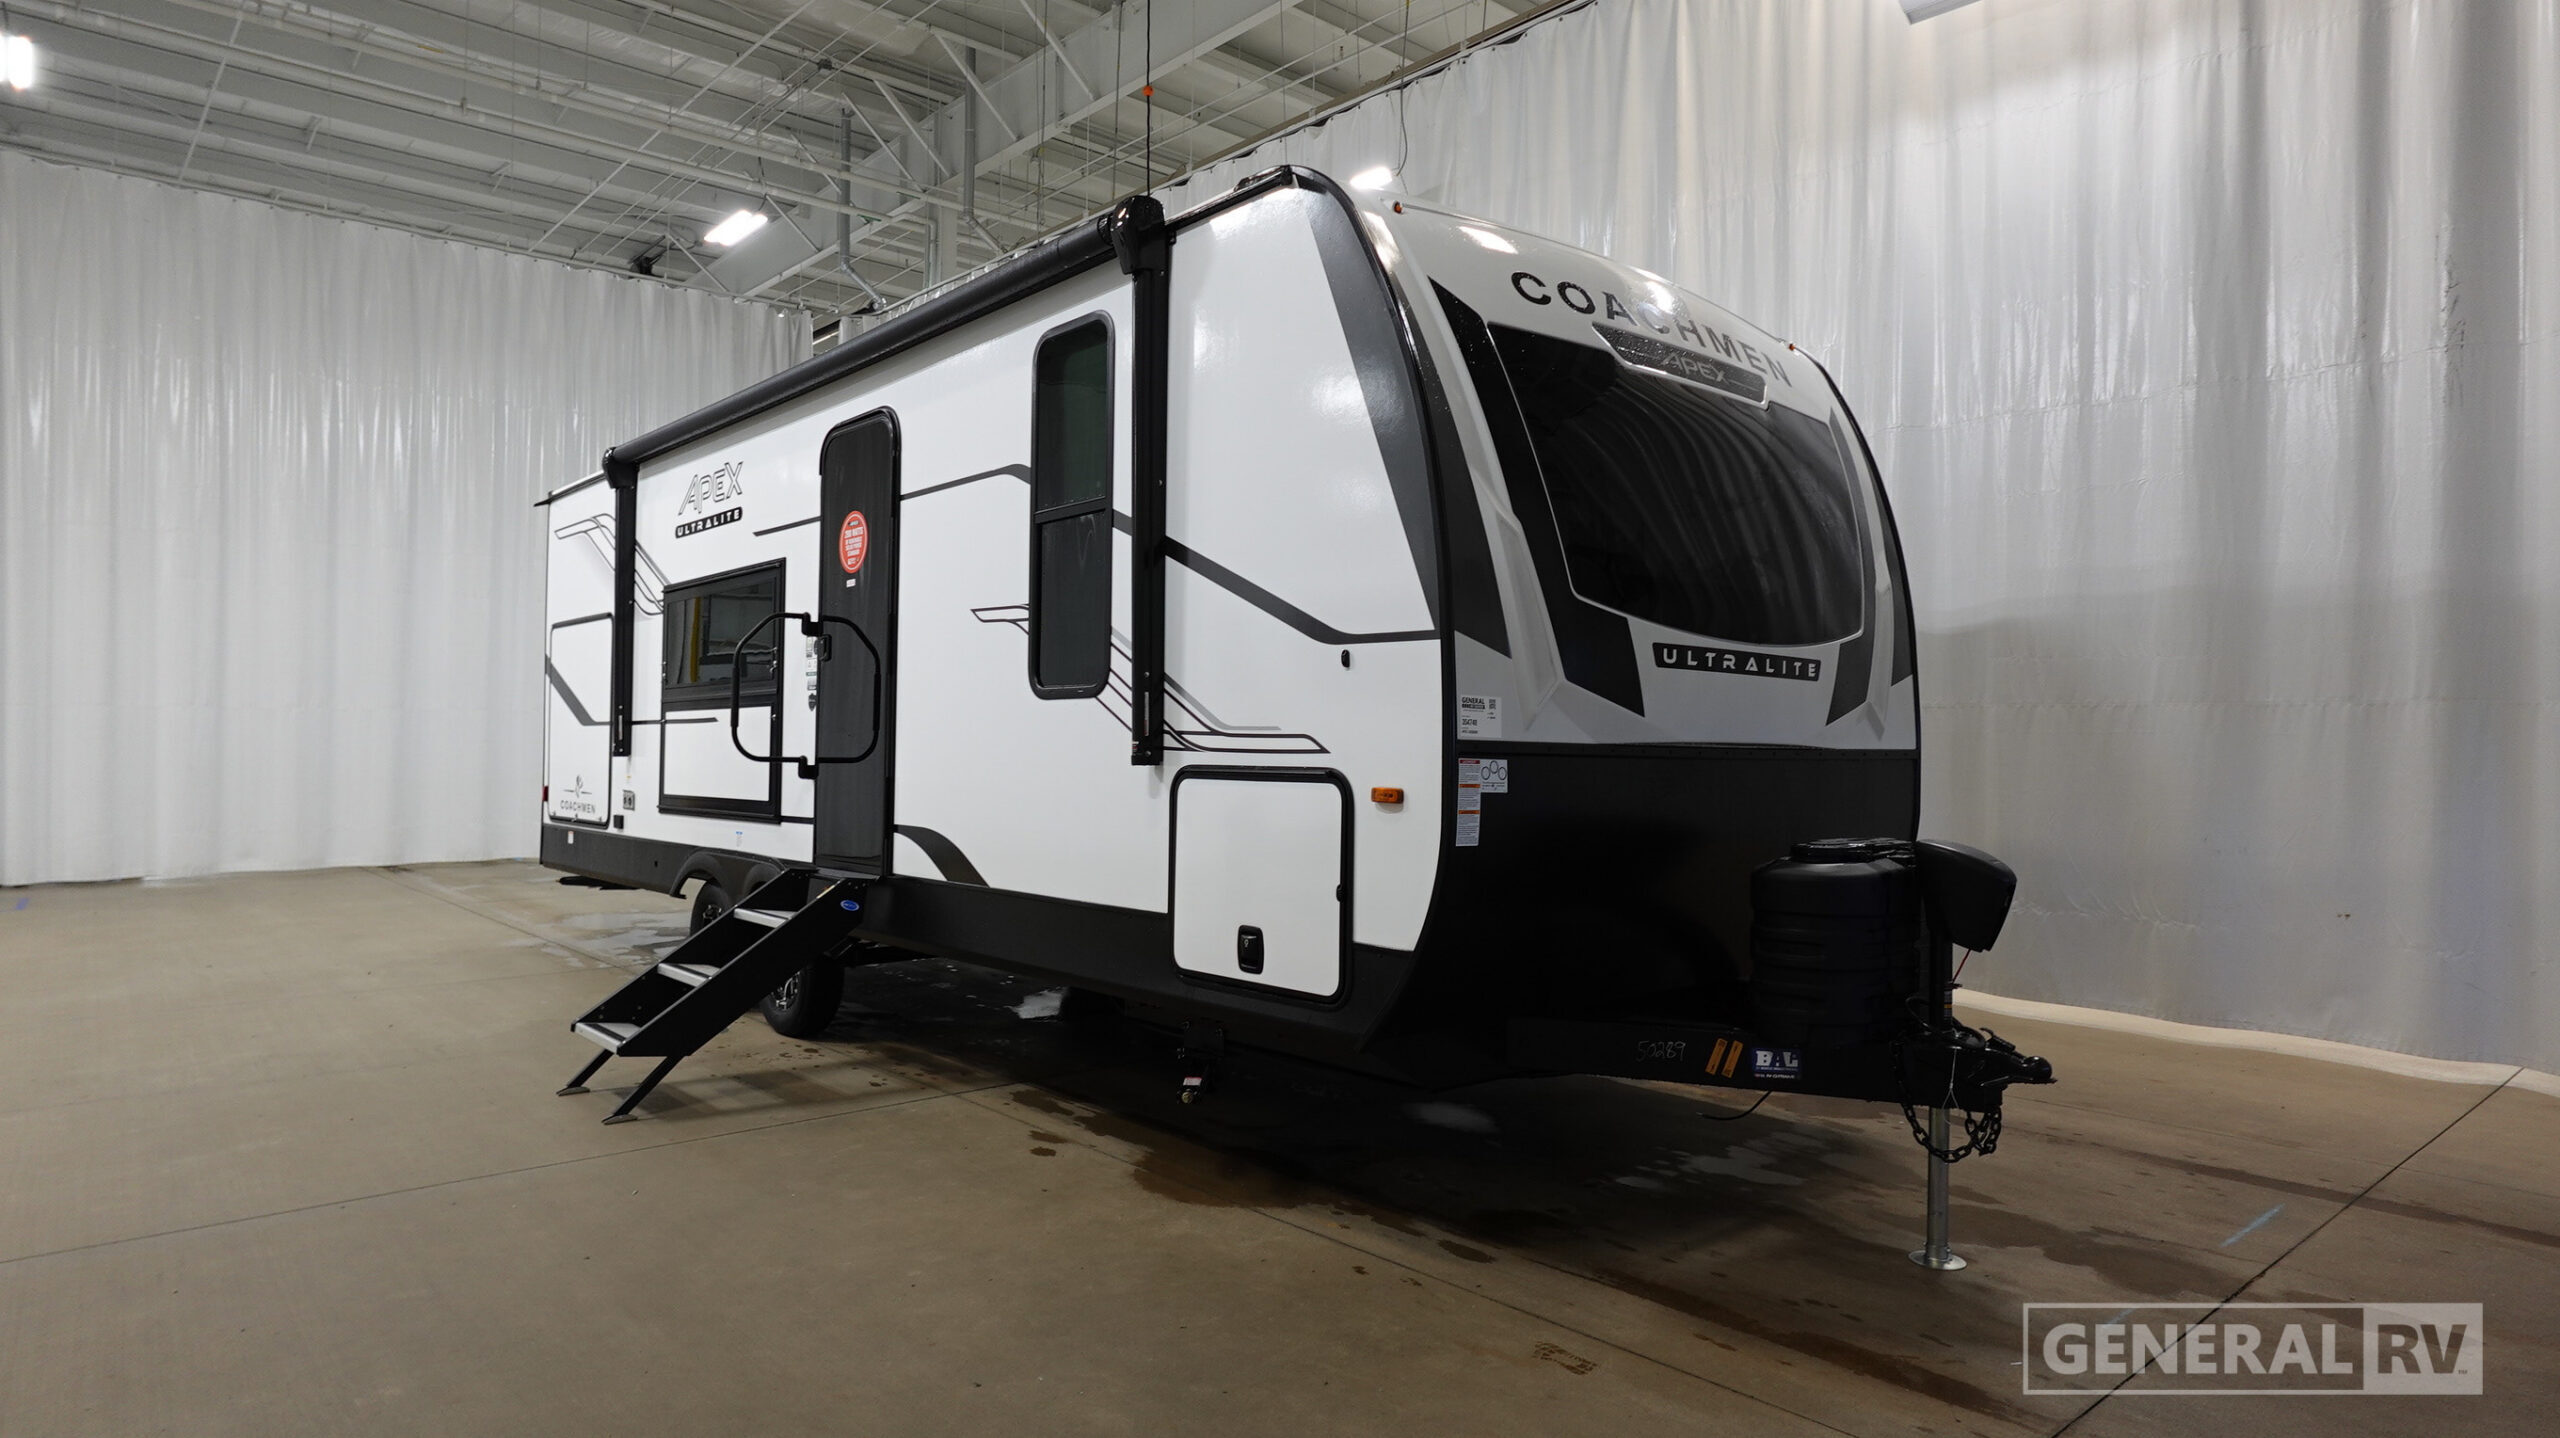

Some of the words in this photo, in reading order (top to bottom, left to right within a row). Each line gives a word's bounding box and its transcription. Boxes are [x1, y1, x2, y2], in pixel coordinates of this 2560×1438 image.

[1511, 271, 1793, 388] COACHMEN
[1661, 351, 1729, 383] APEX
[678, 461, 743, 515] APEX
[677, 509, 740, 537] ULTRALITE
[1662, 647, 1817, 678] ULTRALITE
[560, 800, 595, 813] COACHMEN
[1636, 1041, 1686, 1062] 50289
